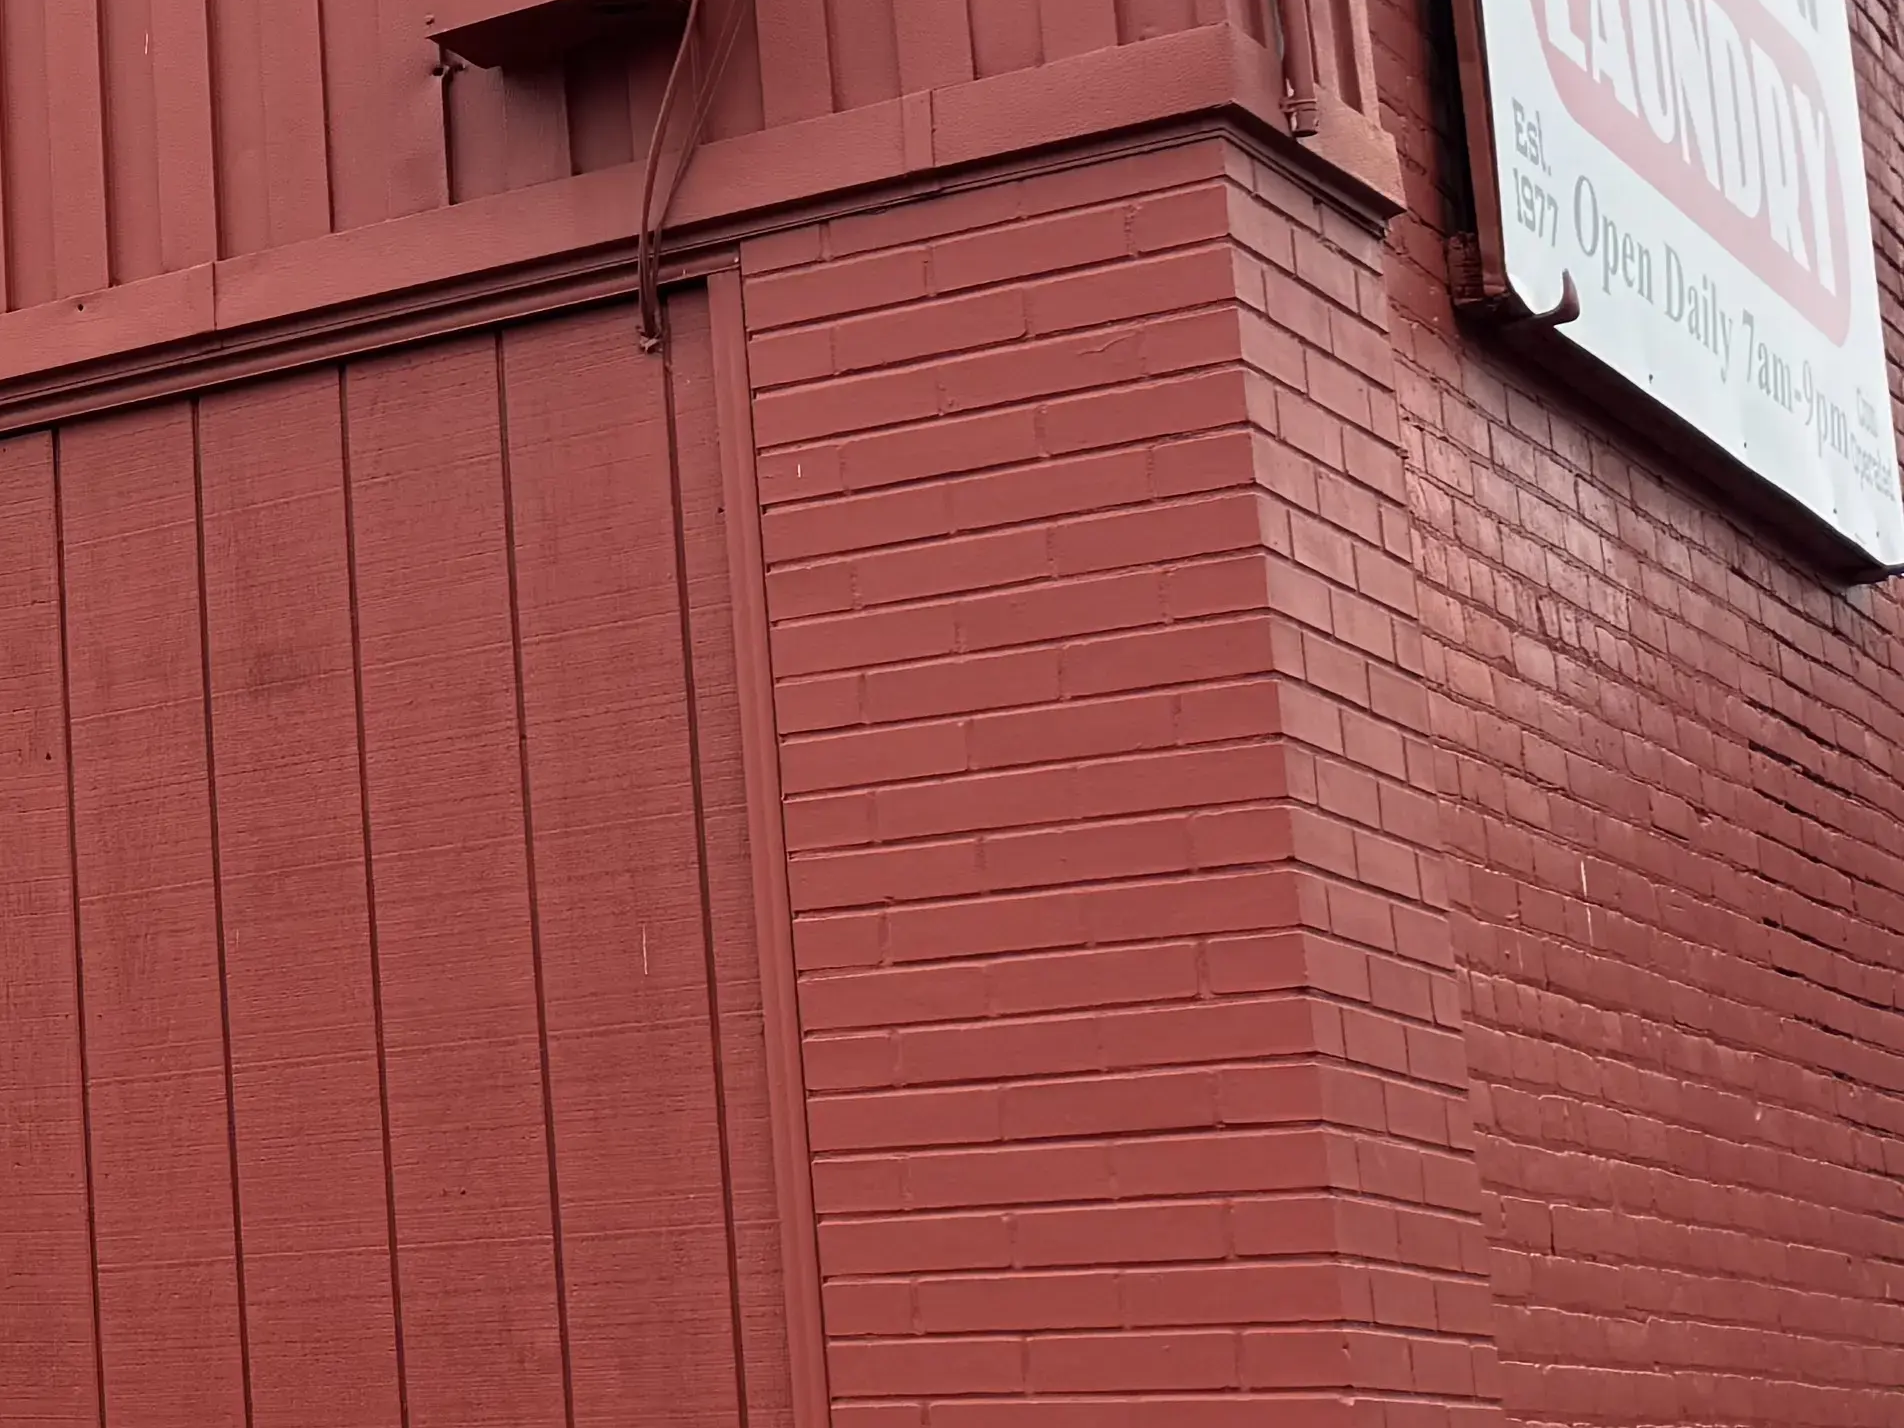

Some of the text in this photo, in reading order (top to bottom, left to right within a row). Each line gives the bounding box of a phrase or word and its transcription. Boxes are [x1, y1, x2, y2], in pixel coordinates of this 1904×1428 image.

[1512, 97, 1552, 177] Est.
[1513, 167, 1559, 248] 1977
[1574, 174, 1849, 460] Open Daily 7am-9pm
